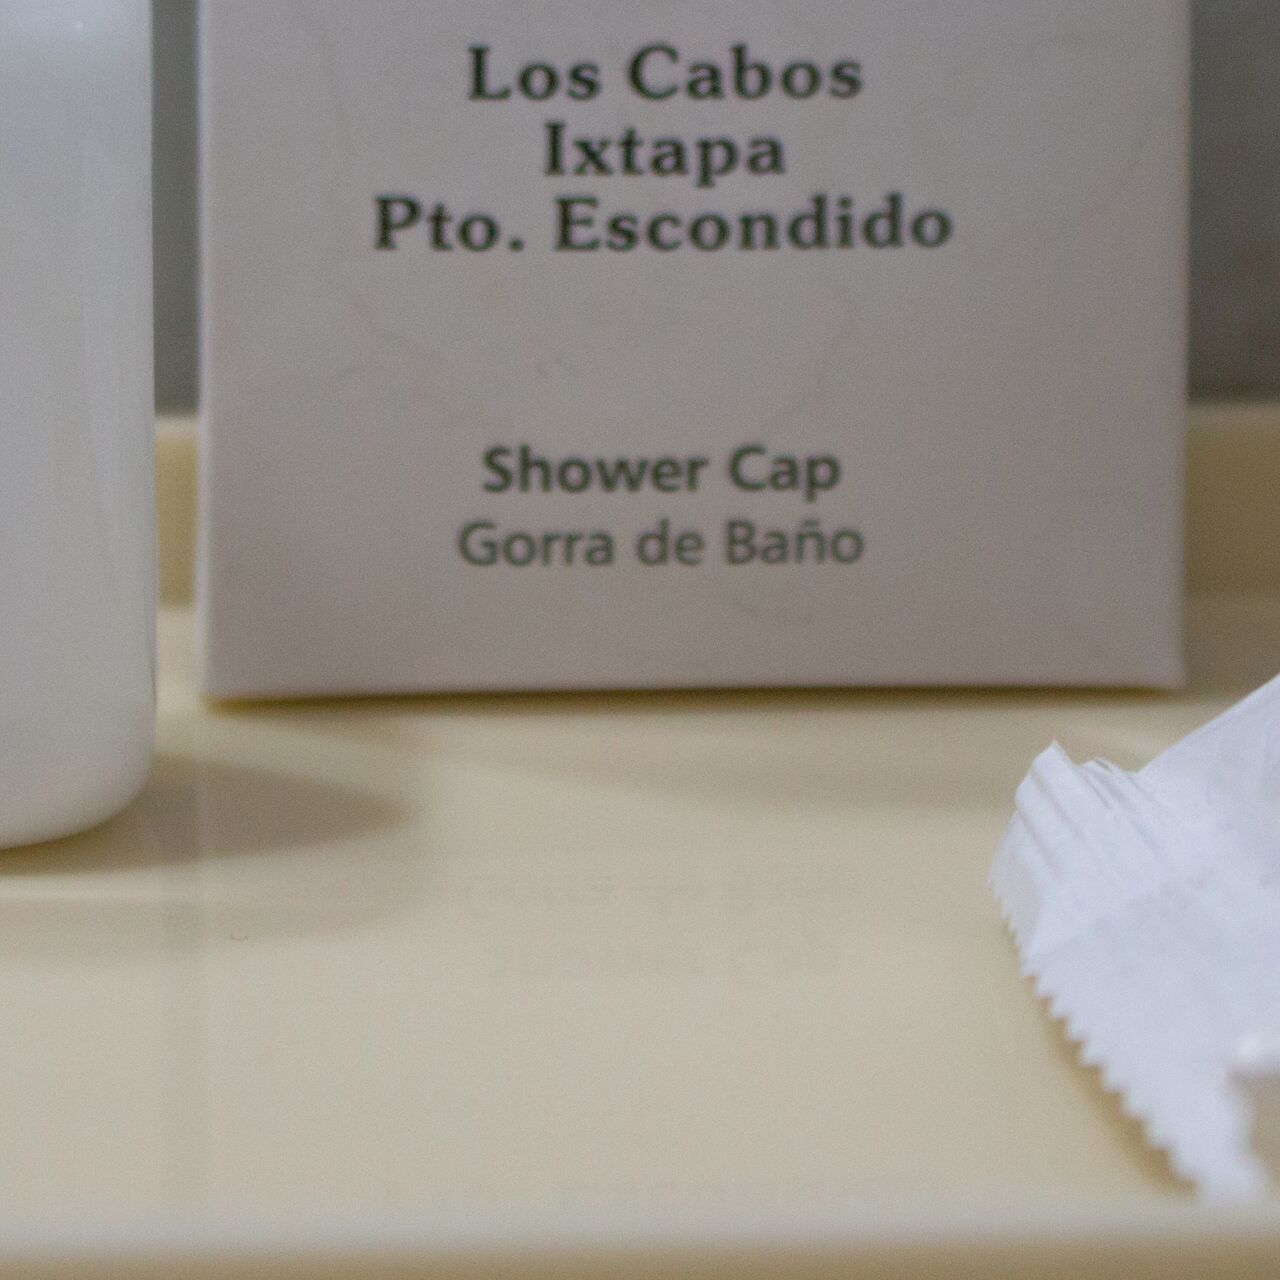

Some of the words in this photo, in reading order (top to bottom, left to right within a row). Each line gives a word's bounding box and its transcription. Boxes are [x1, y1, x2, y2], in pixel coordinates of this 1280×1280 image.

[469, 45, 600, 100] Los
[627, 43, 863, 101] Cabos
[545, 121, 785, 187] Ixtapa
[376, 196, 524, 253] Pto.
[556, 191, 954, 253] Escondido
[482, 445, 708, 494] Shower
[727, 444, 842, 501] Cap
[457, 520, 615, 568] Gorra
[635, 518, 705, 568] de
[725, 519, 865, 567] Baño
